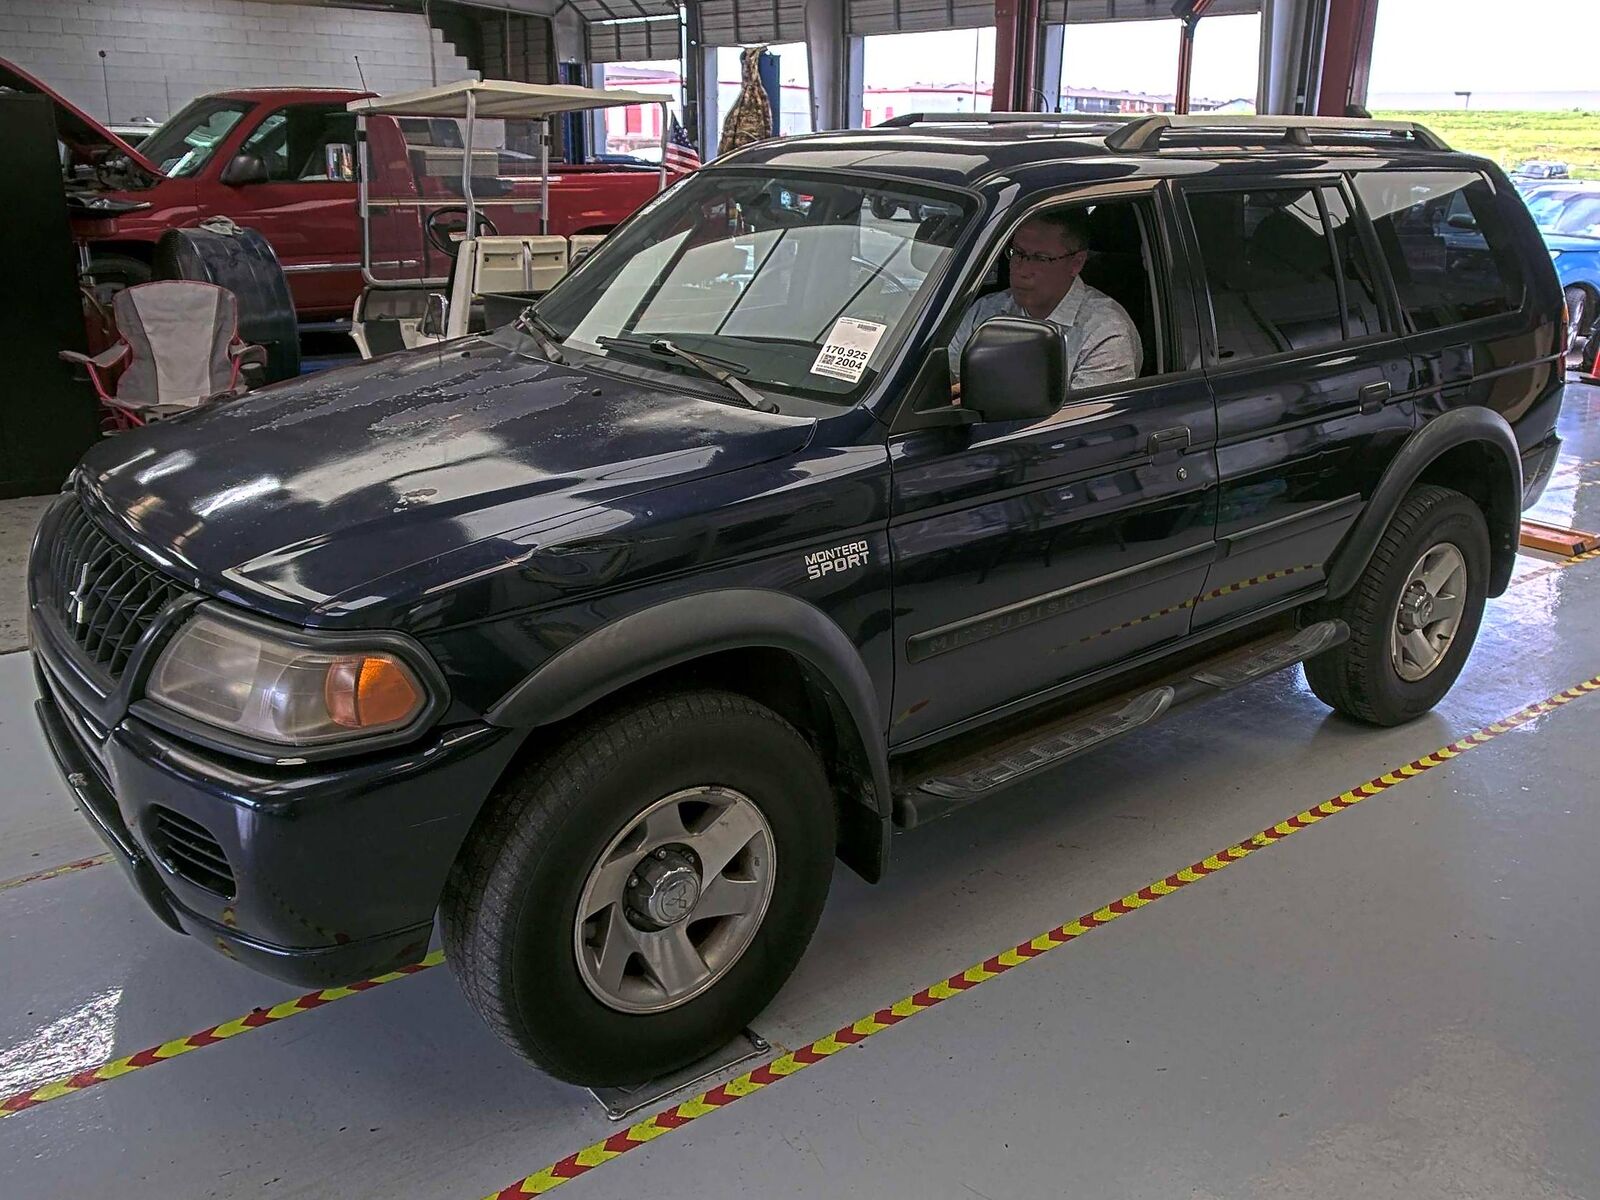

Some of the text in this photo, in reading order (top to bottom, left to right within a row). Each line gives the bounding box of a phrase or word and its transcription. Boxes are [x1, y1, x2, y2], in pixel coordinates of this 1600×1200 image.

[826, 345, 868, 360] 170,925
[835, 357, 863, 370] 2004
[804, 540, 868, 566] MONTERO
[807, 551, 870, 580] SPORT
